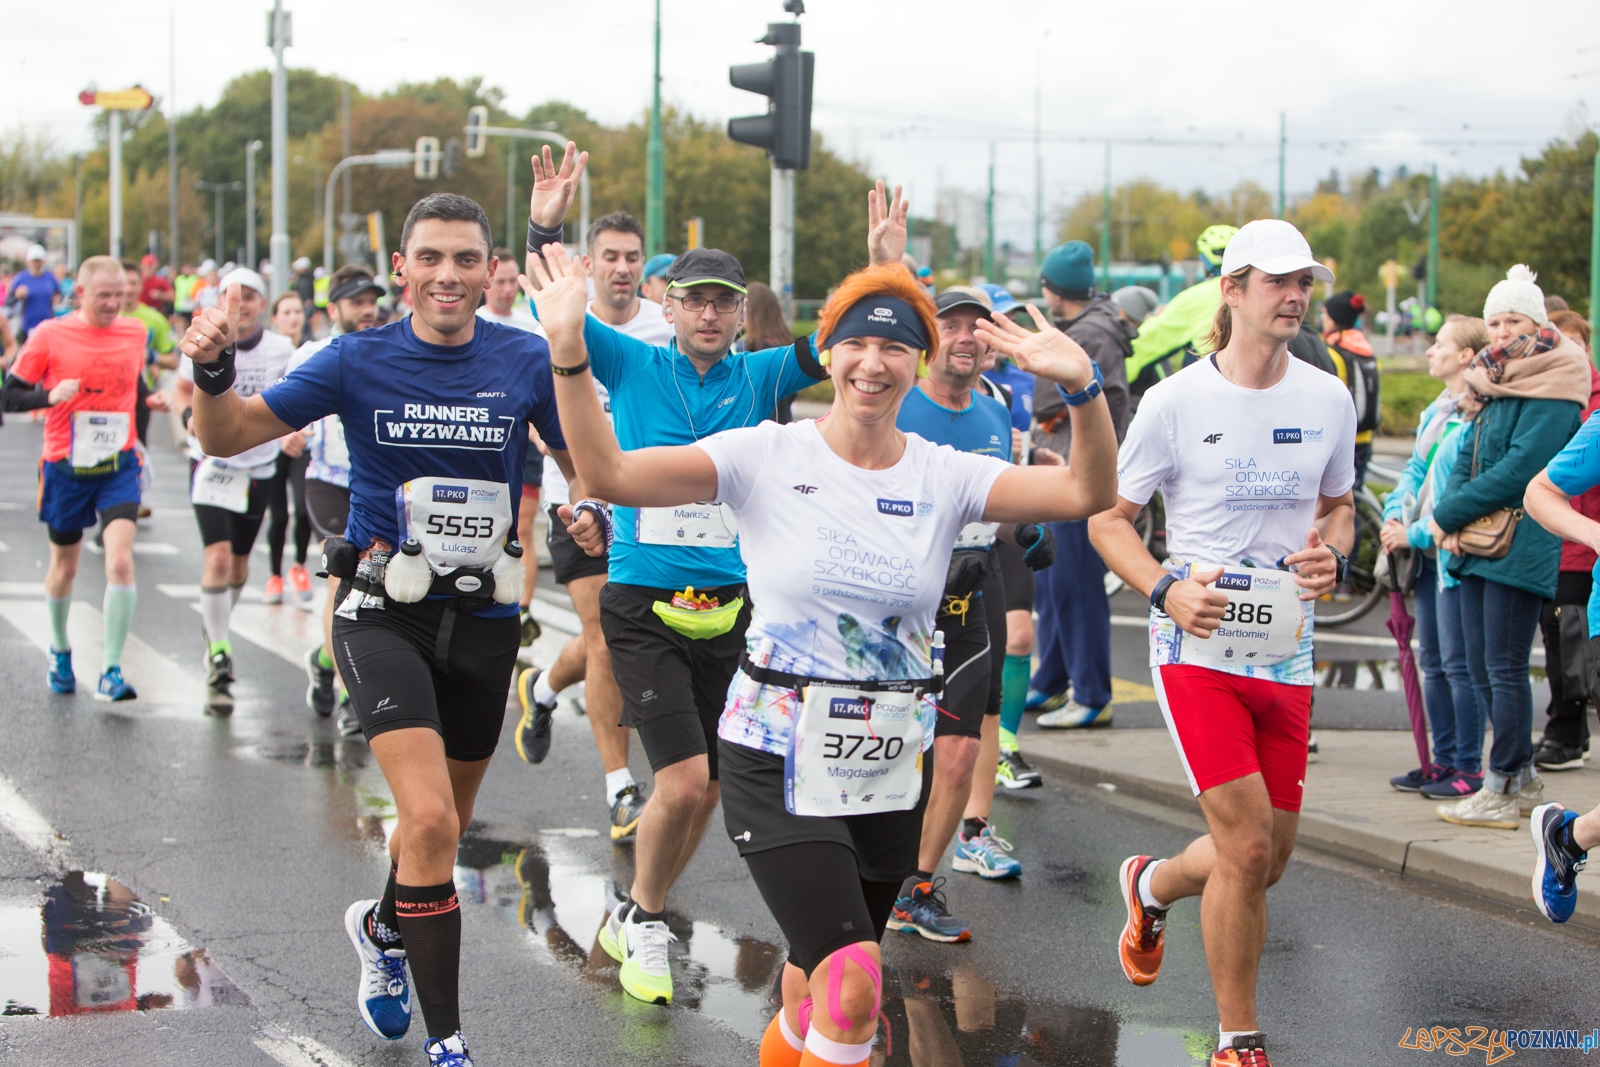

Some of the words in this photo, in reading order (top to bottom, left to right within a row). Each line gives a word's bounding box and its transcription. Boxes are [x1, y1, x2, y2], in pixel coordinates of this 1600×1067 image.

[404, 403, 490, 423] RUNNER'S
[386, 421, 505, 442] WYZWANIE
[1203, 433, 1223, 444] 4F
[1224, 457, 1258, 470] SIŁA
[1235, 470, 1301, 482] ODWAGA
[793, 484, 818, 494] 4F
[1225, 482, 1300, 497] SZYBKOŚĆ
[1280, 502, 1297, 510] 2016
[674, 509, 711, 519] Mariusz
[426, 514, 494, 538] 5553
[816, 526, 858, 547] SIŁA
[441, 542, 478, 553] Łukasz
[828, 546, 916, 573] ODWAGA
[813, 559, 916, 590] SZYBKOŚĆ
[812, 584, 820, 594] 9
[889, 597, 914, 609] 2016
[823, 733, 904, 761] 3720
[827, 766, 890, 779] Magdalena
[861, 793, 875, 802] 4F
